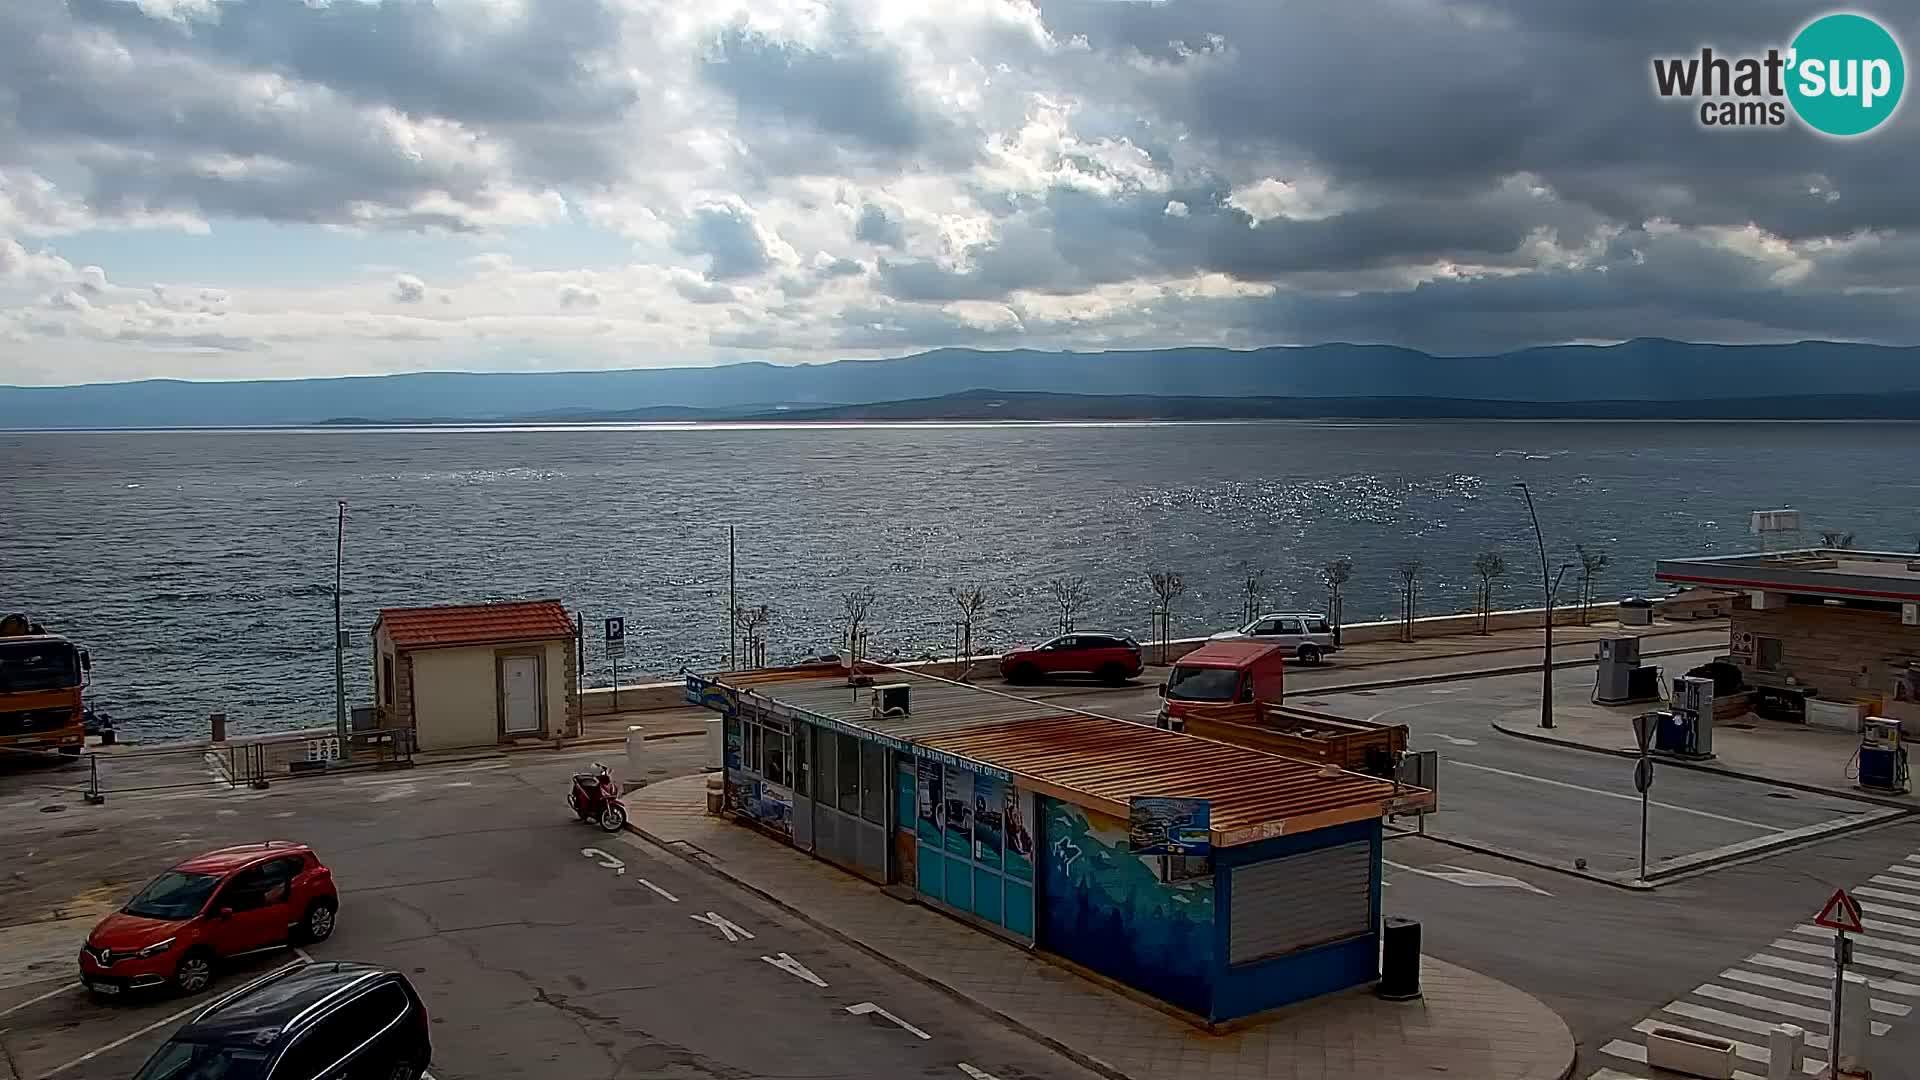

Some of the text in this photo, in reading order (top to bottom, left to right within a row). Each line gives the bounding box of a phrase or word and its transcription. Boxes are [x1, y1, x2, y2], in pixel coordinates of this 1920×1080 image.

[609, 620, 620, 637] P
[912, 746, 926, 758] BUS
[926, 751, 957, 767] STATION
[959, 759, 983, 776] TICKET
[984, 766, 1009, 782] OFFICE
